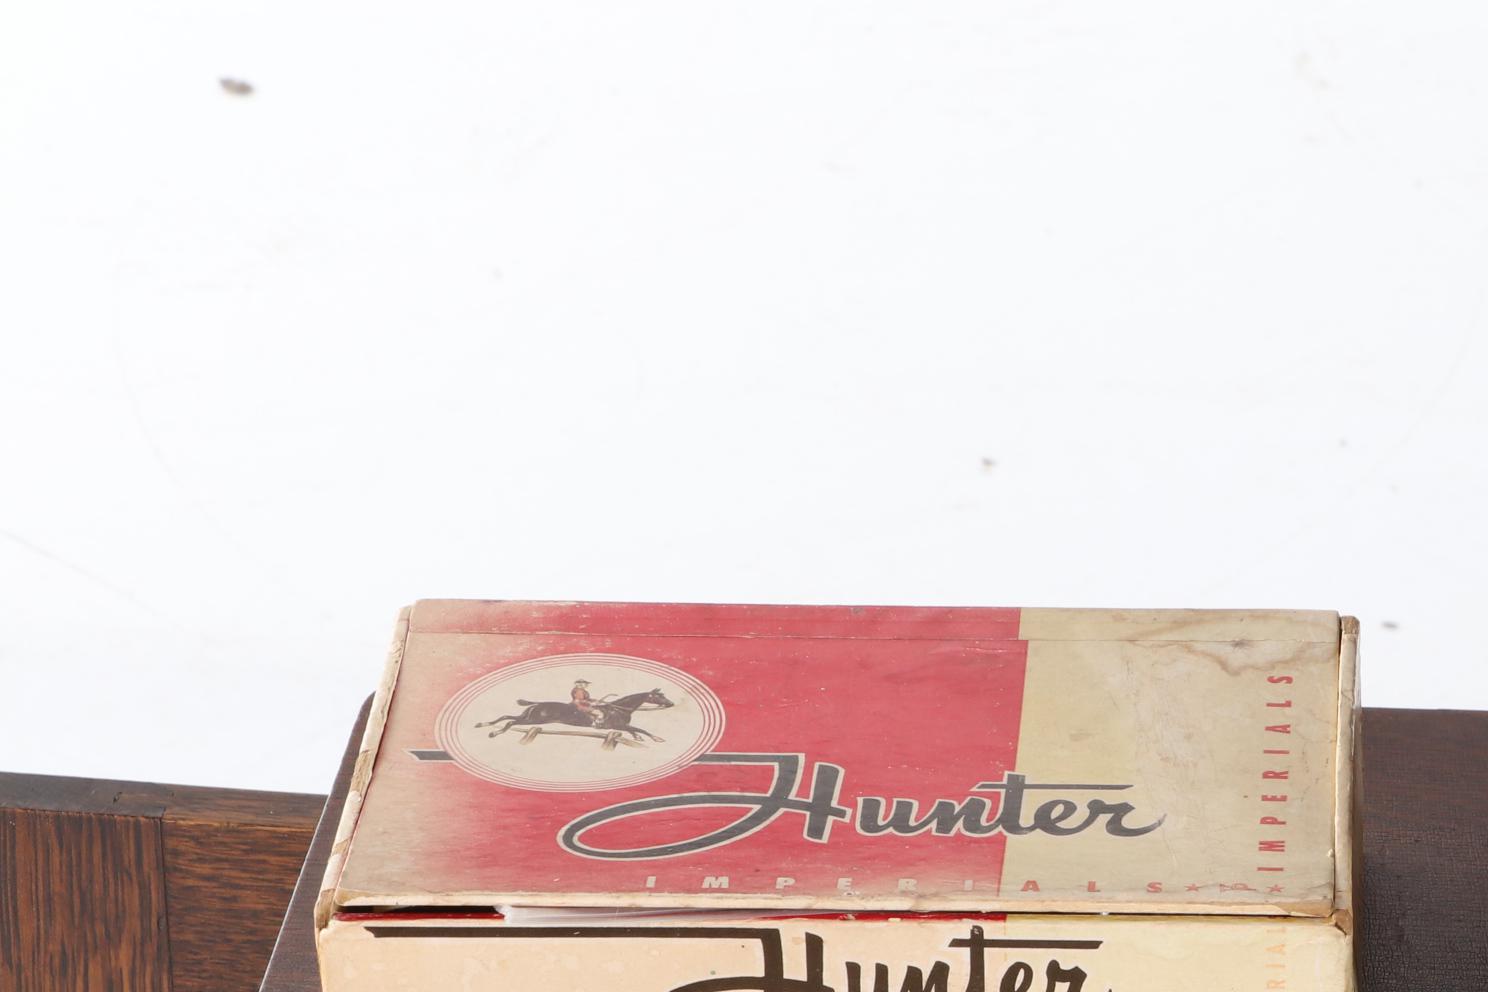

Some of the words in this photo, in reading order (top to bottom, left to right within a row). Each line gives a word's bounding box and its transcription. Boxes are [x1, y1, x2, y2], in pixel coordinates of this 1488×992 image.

[408, 749, 1168, 860] Hunter
[1256, 675, 1294, 872] IMPERIALS
[644, 875, 1164, 894] IMPERIALS
